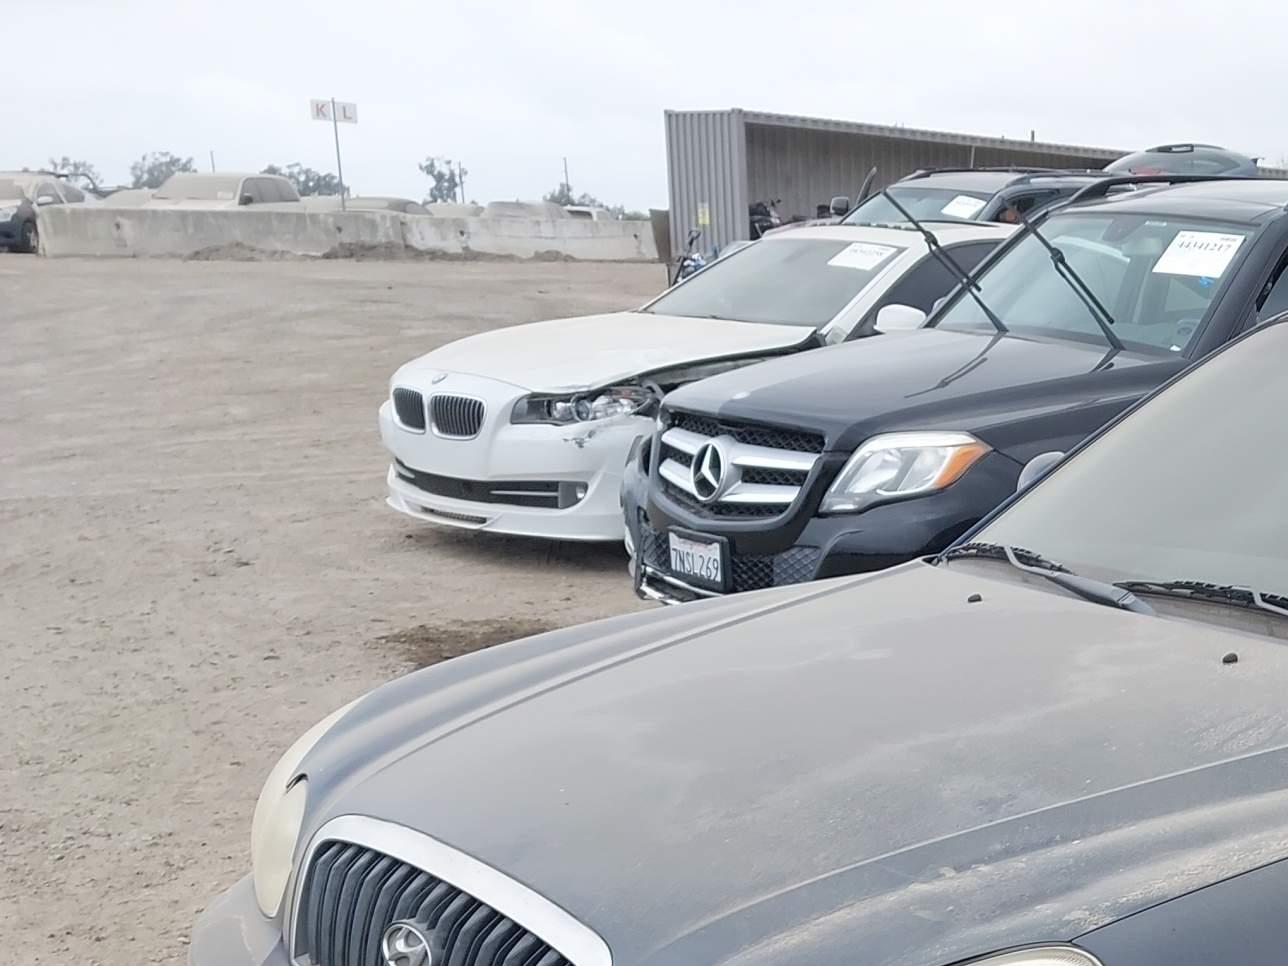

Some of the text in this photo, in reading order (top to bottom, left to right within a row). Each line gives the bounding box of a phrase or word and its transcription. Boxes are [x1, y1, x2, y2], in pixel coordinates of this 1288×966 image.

[315, 103, 328, 117] K
[342, 104, 353, 120] L
[671, 547, 720, 582] 7NSL269
